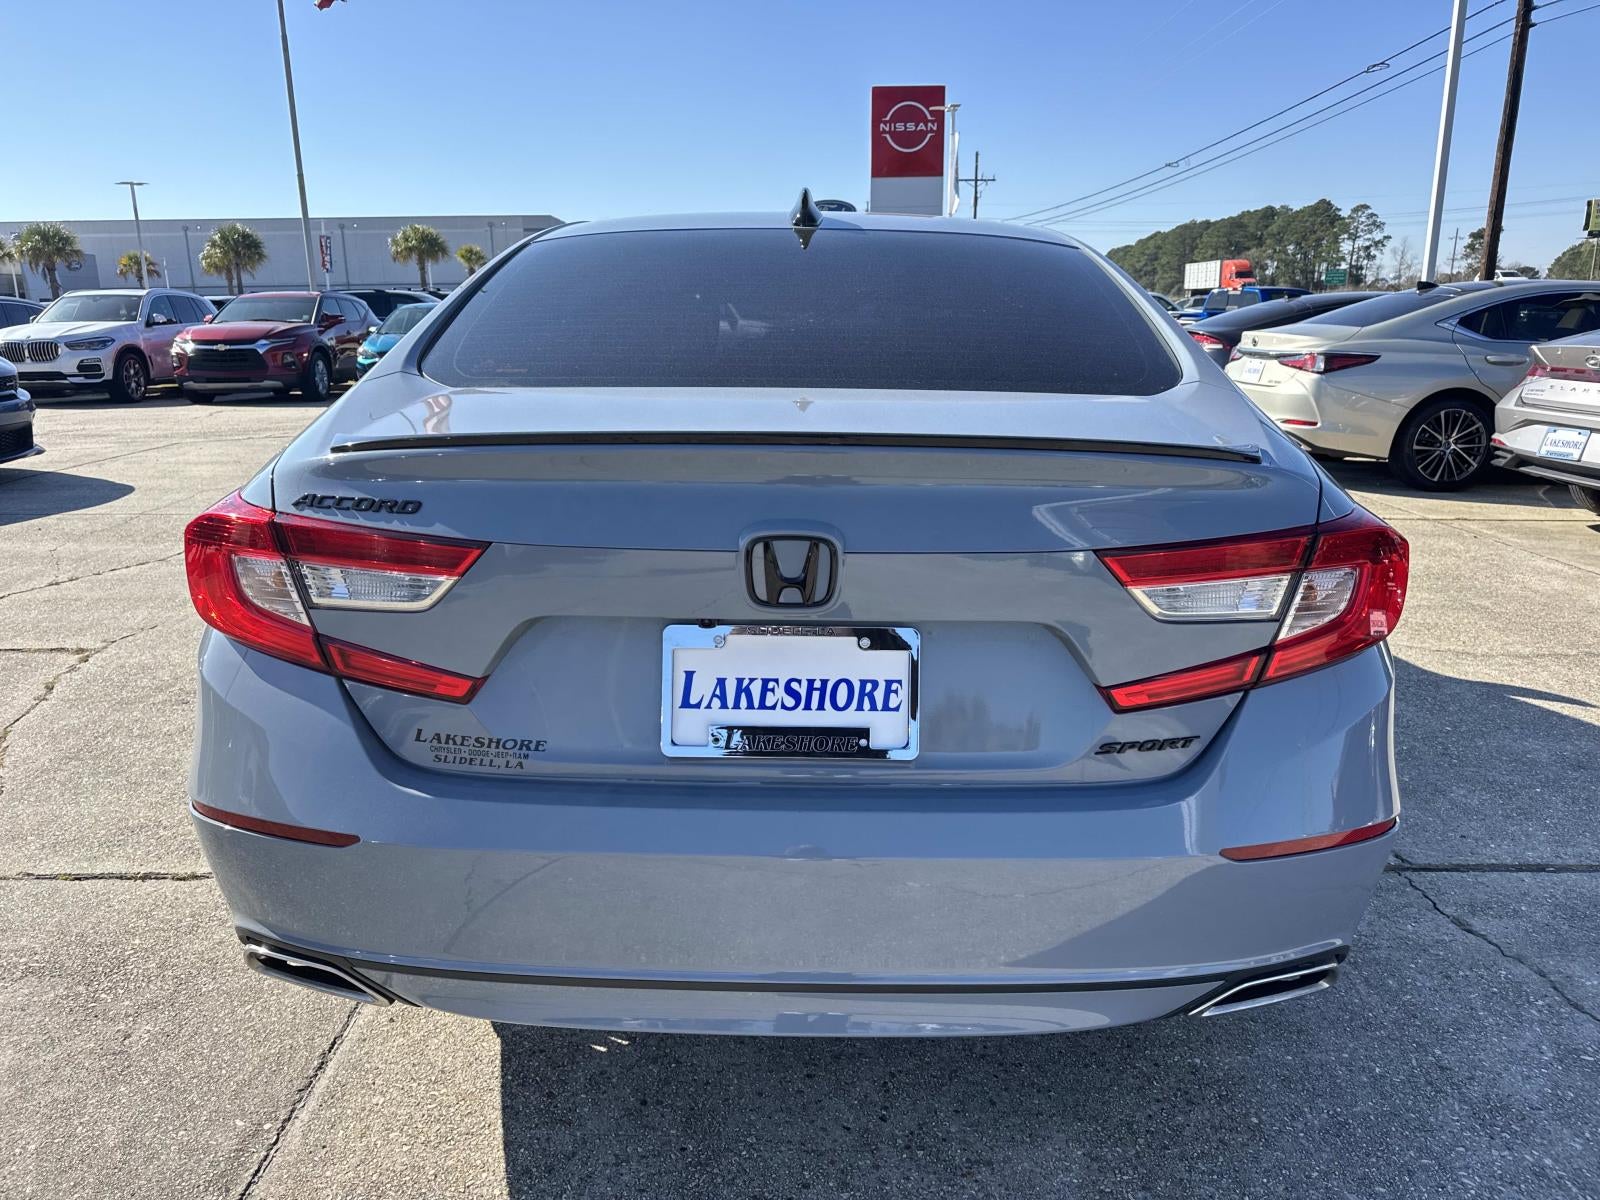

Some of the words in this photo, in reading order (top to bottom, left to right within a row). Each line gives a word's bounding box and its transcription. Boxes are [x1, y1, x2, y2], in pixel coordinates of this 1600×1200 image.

[880, 122, 938, 132] NISSAN
[291, 494, 422, 514] ACCORD
[679, 670, 903, 712] LAKESHORE
[414, 728, 547, 752] LAKESHORE
[724, 729, 858, 753] LAKESHORE
[1094, 735, 1201, 756] SPORT
[429, 745, 461, 755] CHRYSLER
[468, 749, 490, 758] DODGE
[433, 754, 500, 769] SLIDELL,
[505, 760, 524, 770] LA
